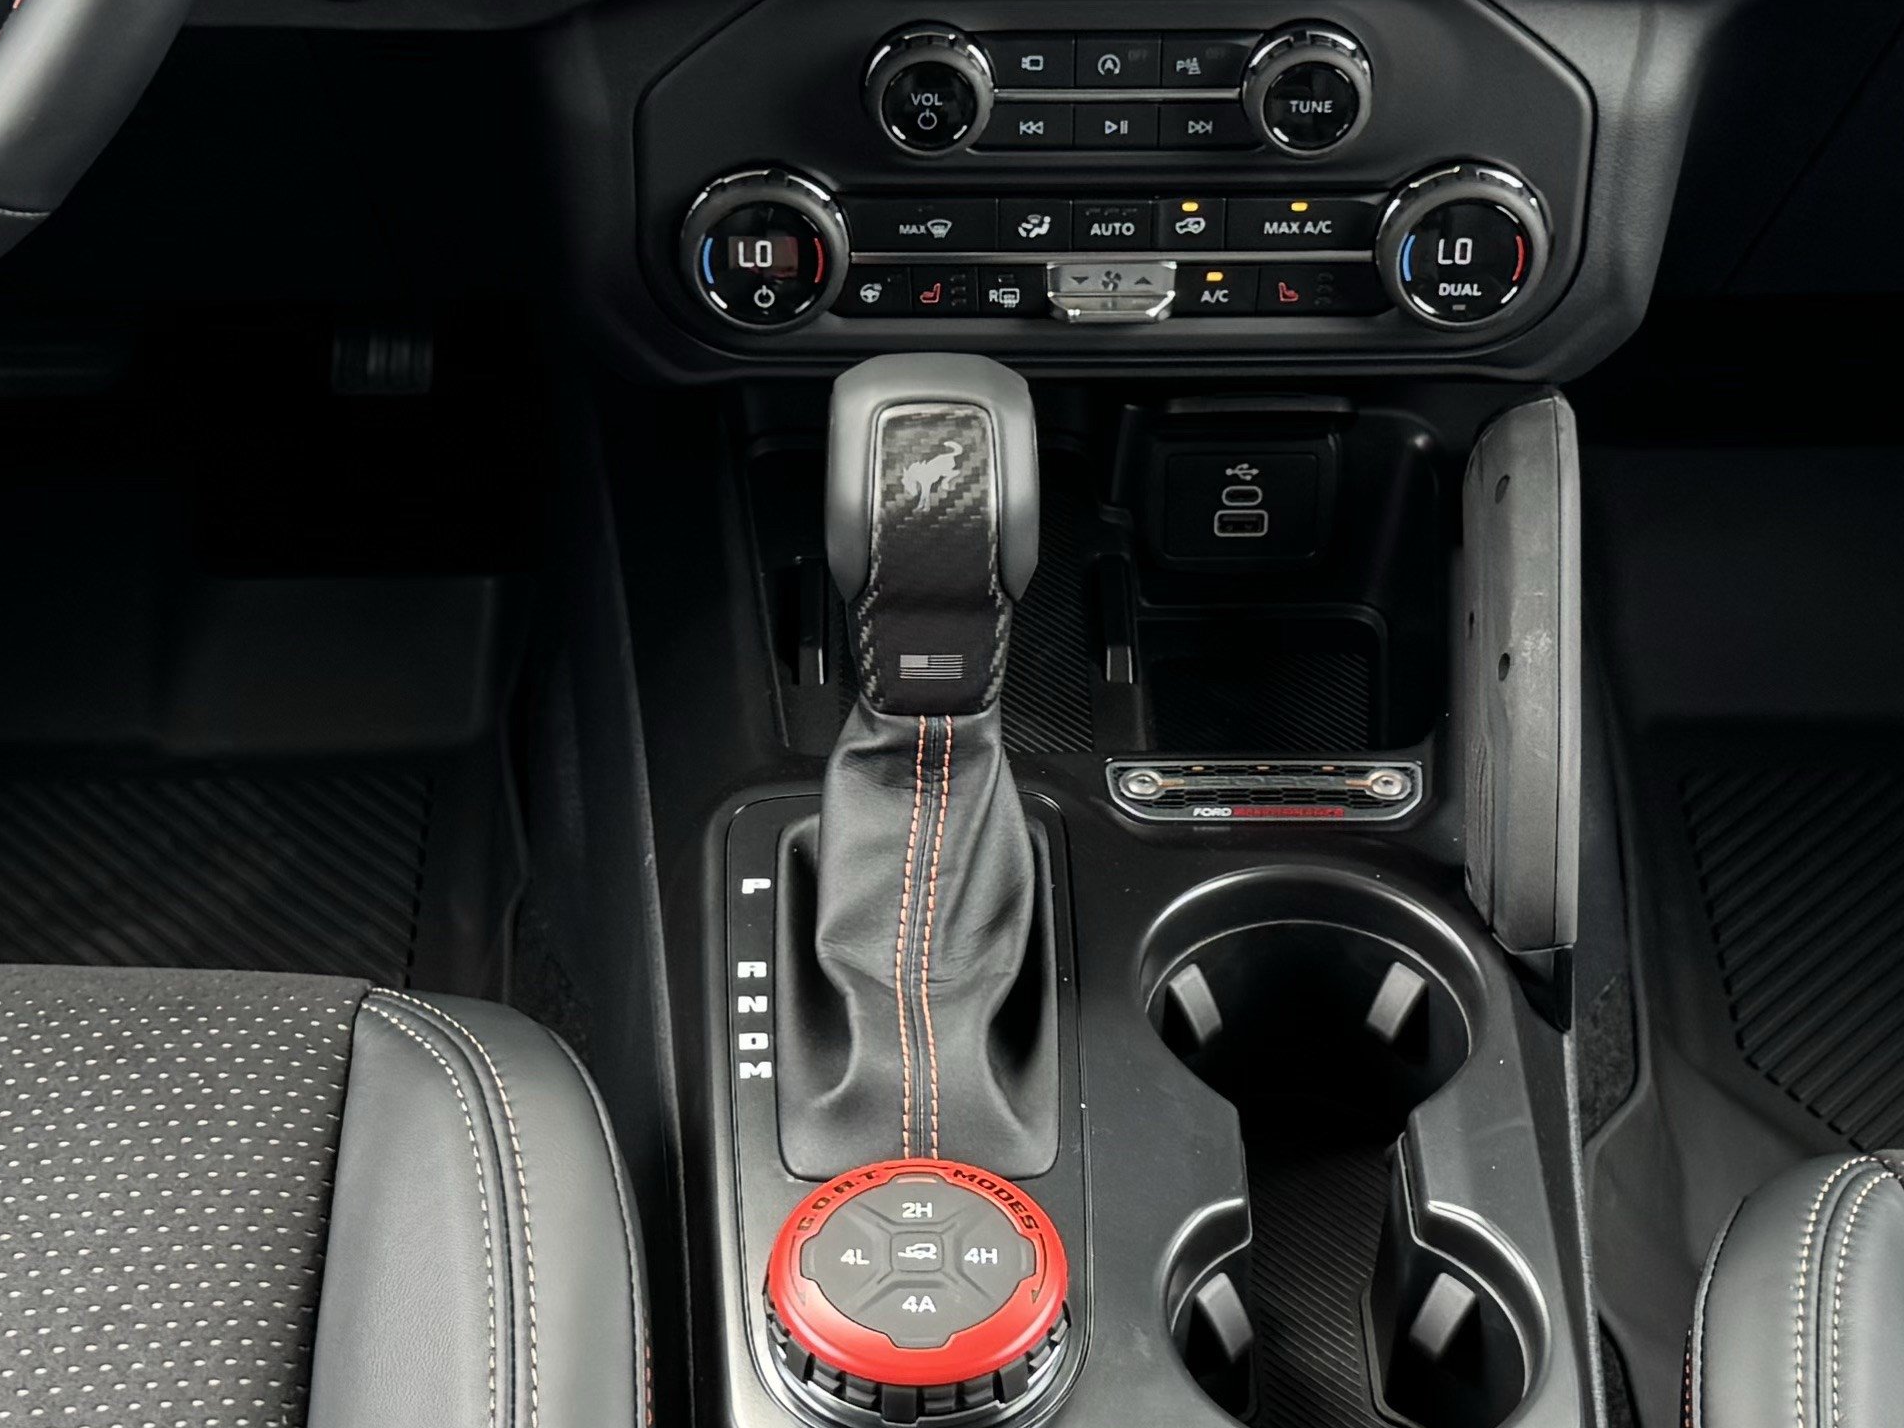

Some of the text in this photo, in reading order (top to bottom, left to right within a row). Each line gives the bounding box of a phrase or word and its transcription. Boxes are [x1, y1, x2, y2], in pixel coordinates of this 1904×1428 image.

[911, 93, 943, 107] VOL
[1289, 100, 1333, 114] TUNE
[899, 224, 926, 235] MAX
[1090, 222, 1135, 236] AUTO
[1263, 219, 1333, 236] MAX A/C
[737, 240, 774, 268] LO
[1437, 238, 1473, 266] LO
[989, 290, 999, 302] R
[1200, 290, 1230, 304] A/C
[1438, 283, 1482, 297] DUAL
[1193, 807, 1232, 817] FORD
[742, 878, 771, 894] P
[737, 995, 768, 1013] N
[739, 1033, 769, 1050] D
[739, 1061, 773, 1079] M
[953, 1169, 1040, 1232] MODES
[901, 1202, 932, 1218] 2H
[840, 1249, 870, 1265] 4L
[963, 1248, 999, 1264] 4H
[901, 1296, 937, 1313] 4A
